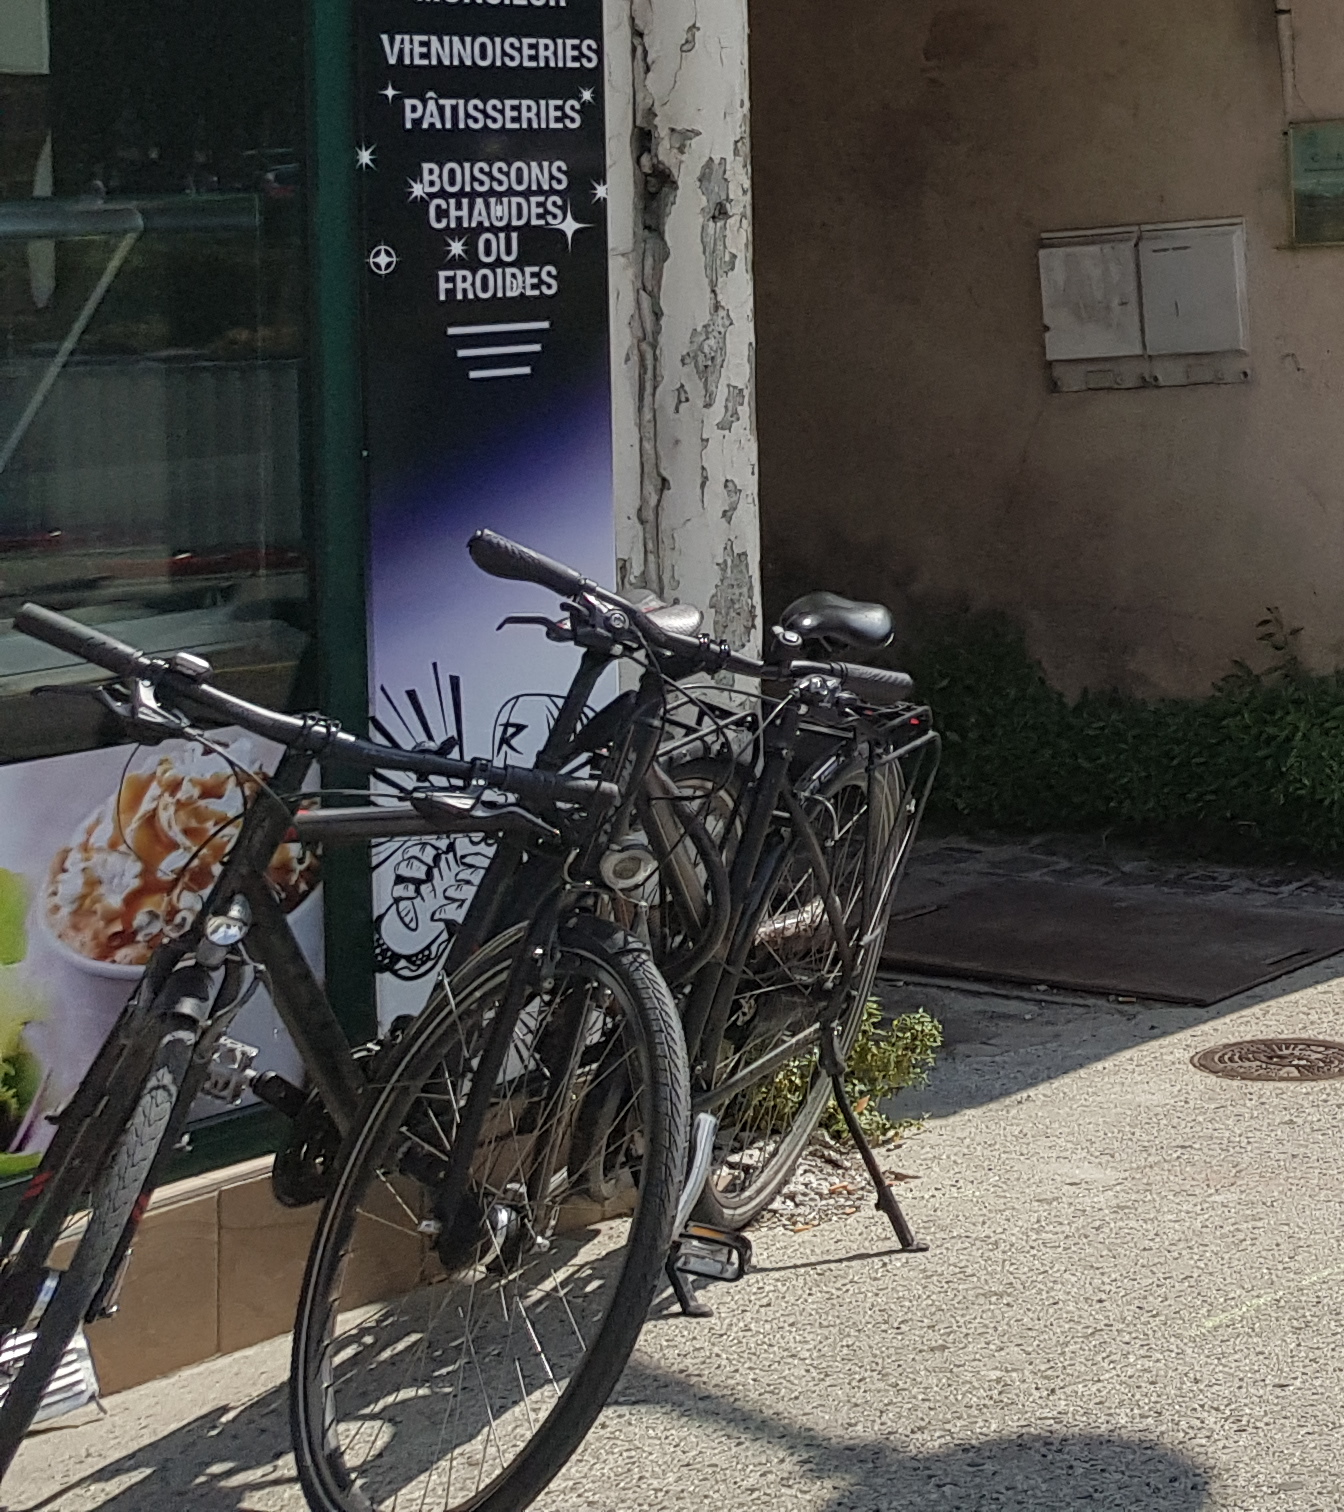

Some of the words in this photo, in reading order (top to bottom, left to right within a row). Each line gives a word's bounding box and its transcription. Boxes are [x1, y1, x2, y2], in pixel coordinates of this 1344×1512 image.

[380, 33, 599, 69] VIENNOISERIES
[403, 91, 582, 130] PÂTISSERIES
[421, 160, 568, 192] BOISSONS
[428, 196, 564, 229] CHAUDES
[477, 232, 518, 264] OU
[438, 266, 558, 301] FROIDES
